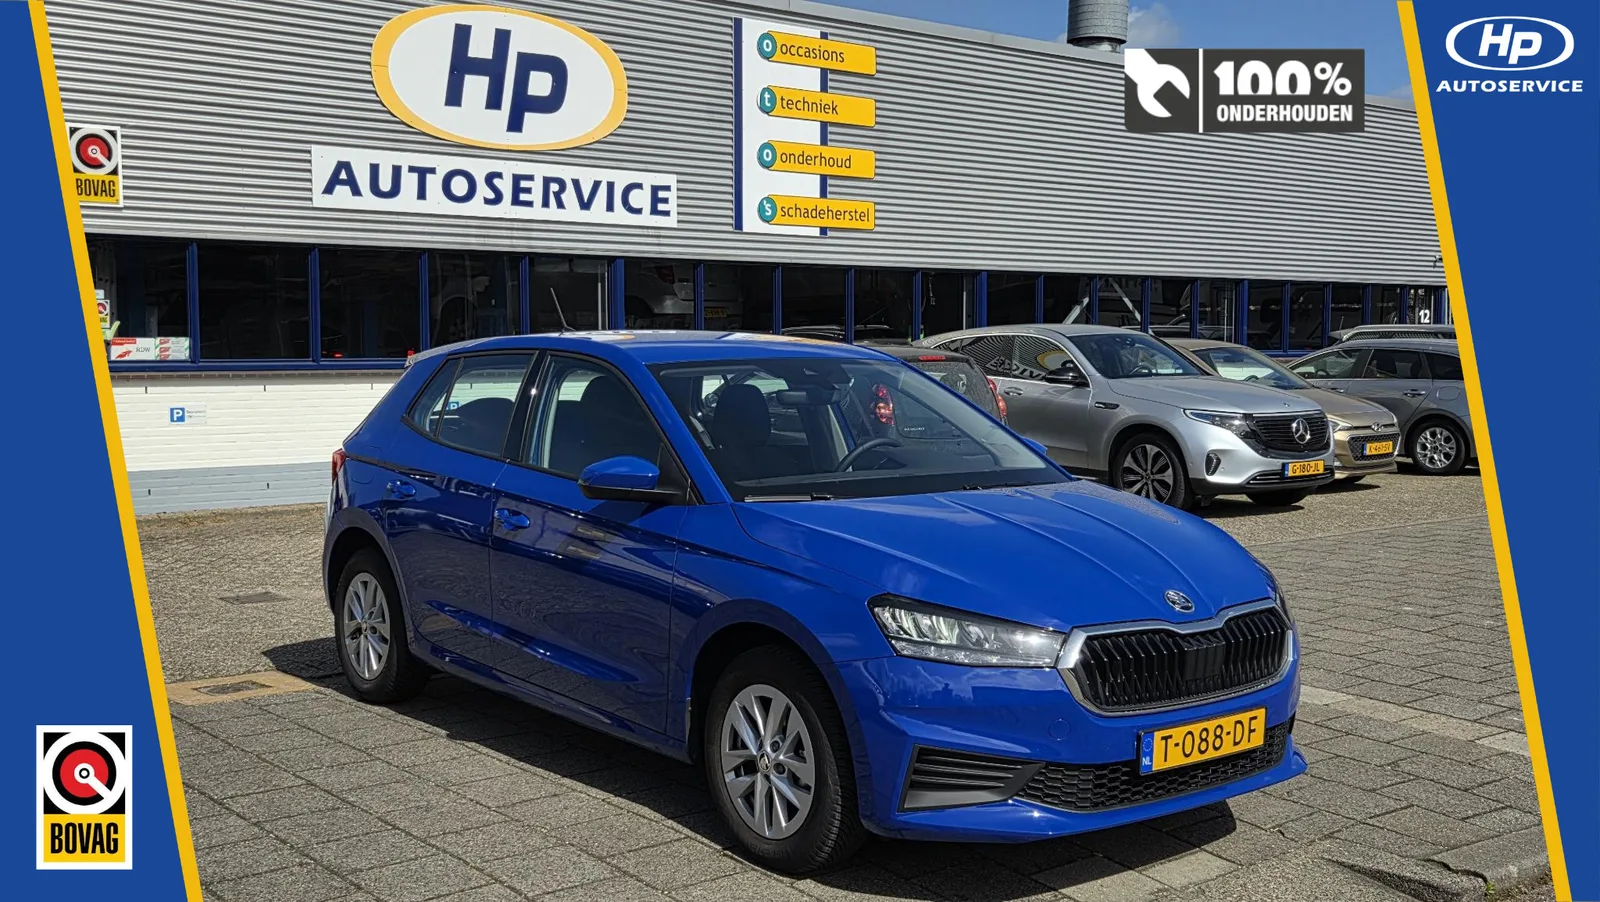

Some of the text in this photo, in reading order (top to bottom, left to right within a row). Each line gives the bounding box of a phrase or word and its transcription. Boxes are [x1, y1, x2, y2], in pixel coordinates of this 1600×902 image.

[780, 43, 845, 63] occasions
[780, 96, 839, 115] techniek
[780, 150, 852, 169] onderhoud
[75, 178, 116, 198] BOVAG
[321, 160, 672, 218] AUTOSERVICE
[780, 203, 870, 222] schadeherstel
[1419, 309, 1430, 323] 12
[173, 409, 183, 421] P
[1291, 461, 1321, 474] G-180-JL
[1160, 715, 1258, 762] T-088-DF
[1142, 756, 1152, 766] NL
